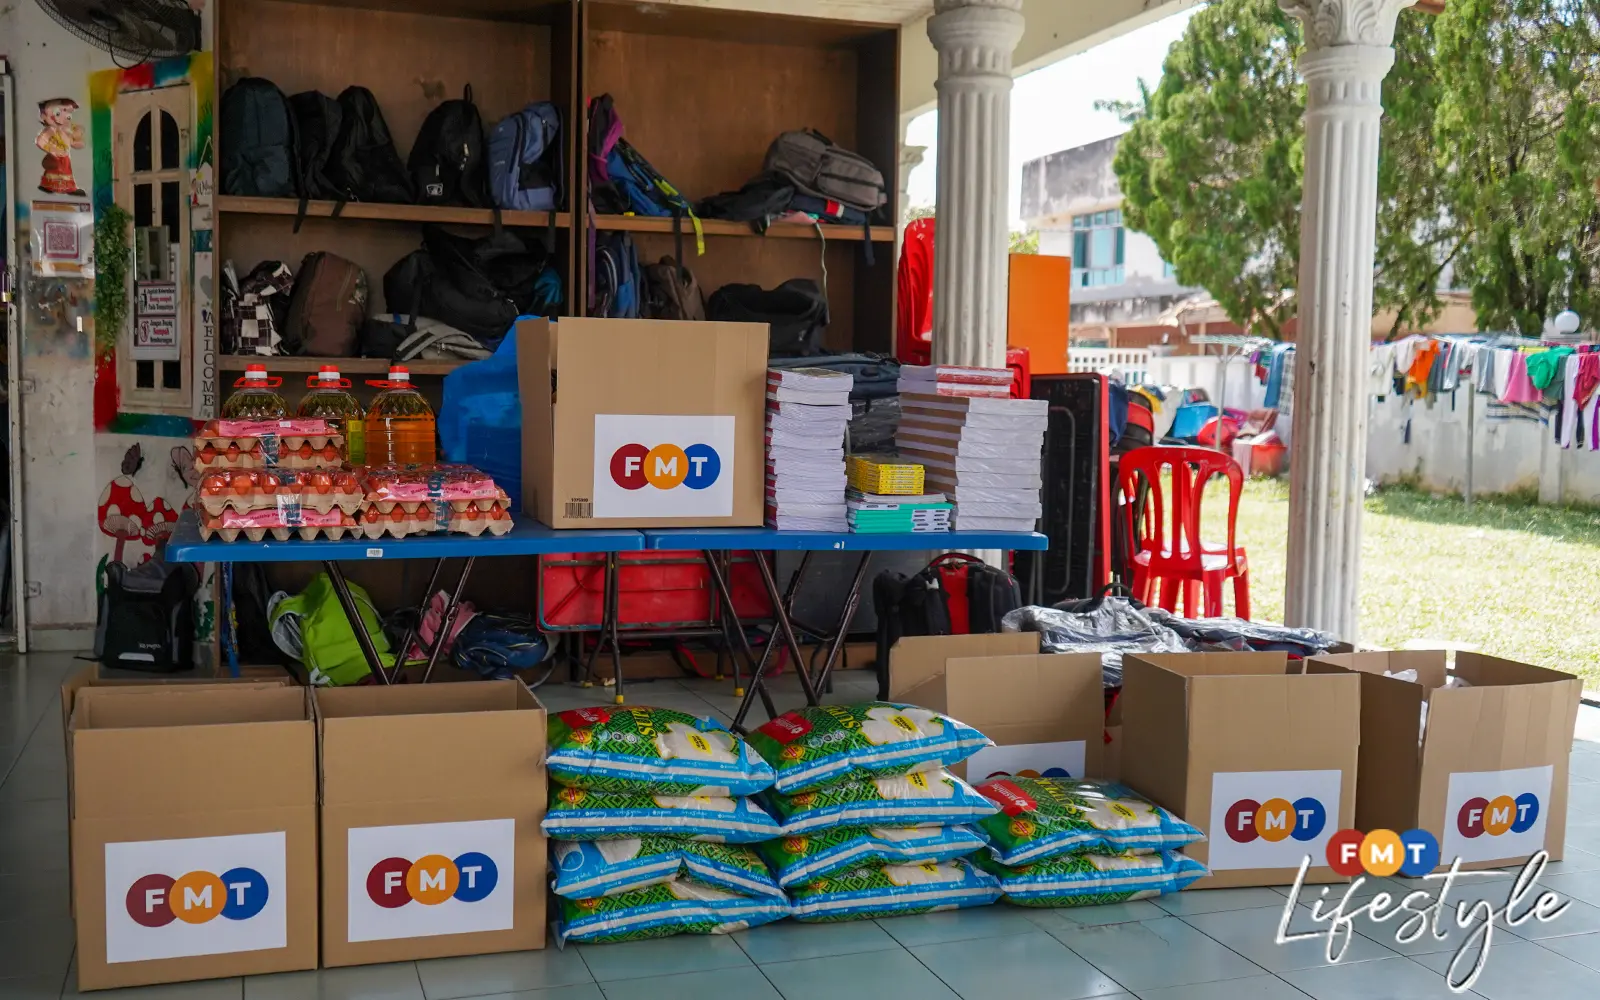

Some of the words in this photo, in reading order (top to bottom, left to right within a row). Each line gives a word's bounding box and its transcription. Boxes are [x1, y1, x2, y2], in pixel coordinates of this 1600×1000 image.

[203, 311, 214, 407] WELCOME
[624, 456, 708, 477] FMT
[1237, 808, 1315, 831] FMT
[1467, 803, 1531, 827] FMT
[384, 864, 482, 895] FMT
[145, 881, 252, 913] FMT
